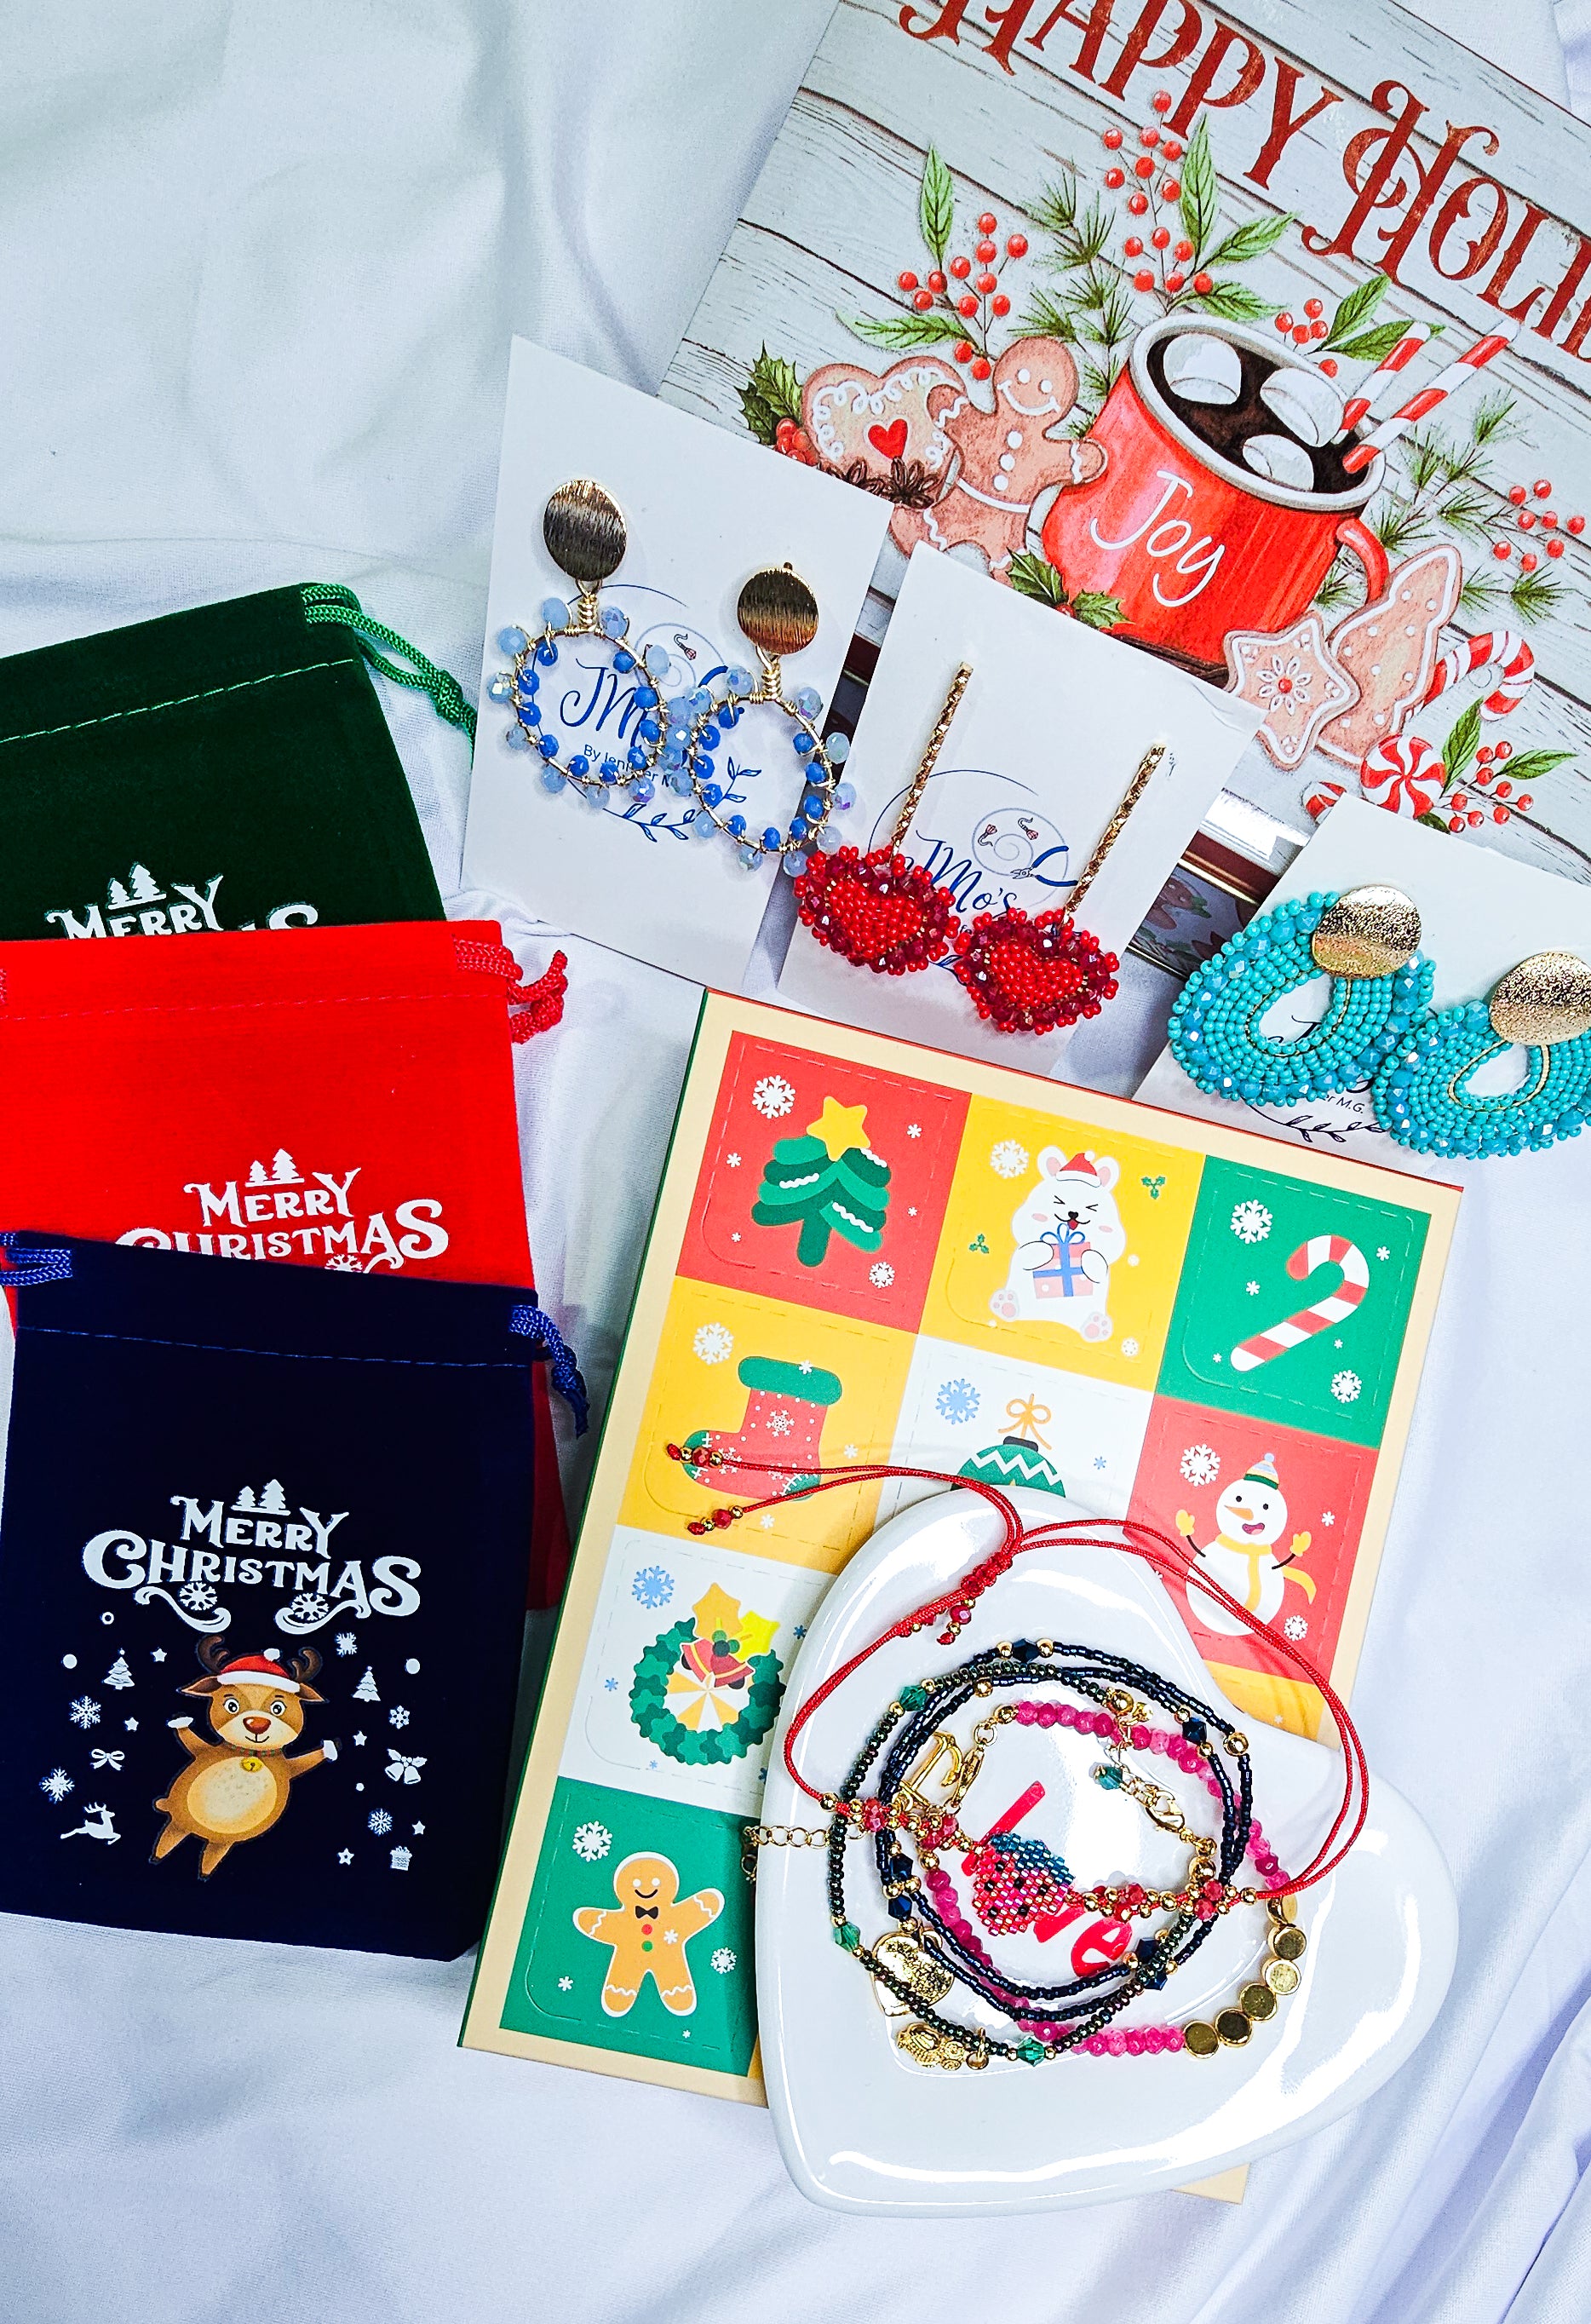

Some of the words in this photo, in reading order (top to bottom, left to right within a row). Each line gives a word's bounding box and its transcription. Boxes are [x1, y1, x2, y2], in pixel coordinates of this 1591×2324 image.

[1301, 79, 1591, 364] HOLI
[1089, 469, 1226, 607] Joy
[583, 744, 601, 762] By
[1335, 1096, 1365, 1114] M.G.
[182, 1166, 362, 1228] MERRY
[169, 1495, 349, 1560] MERRY
[82, 1529, 422, 1618] CHRISTMAS
